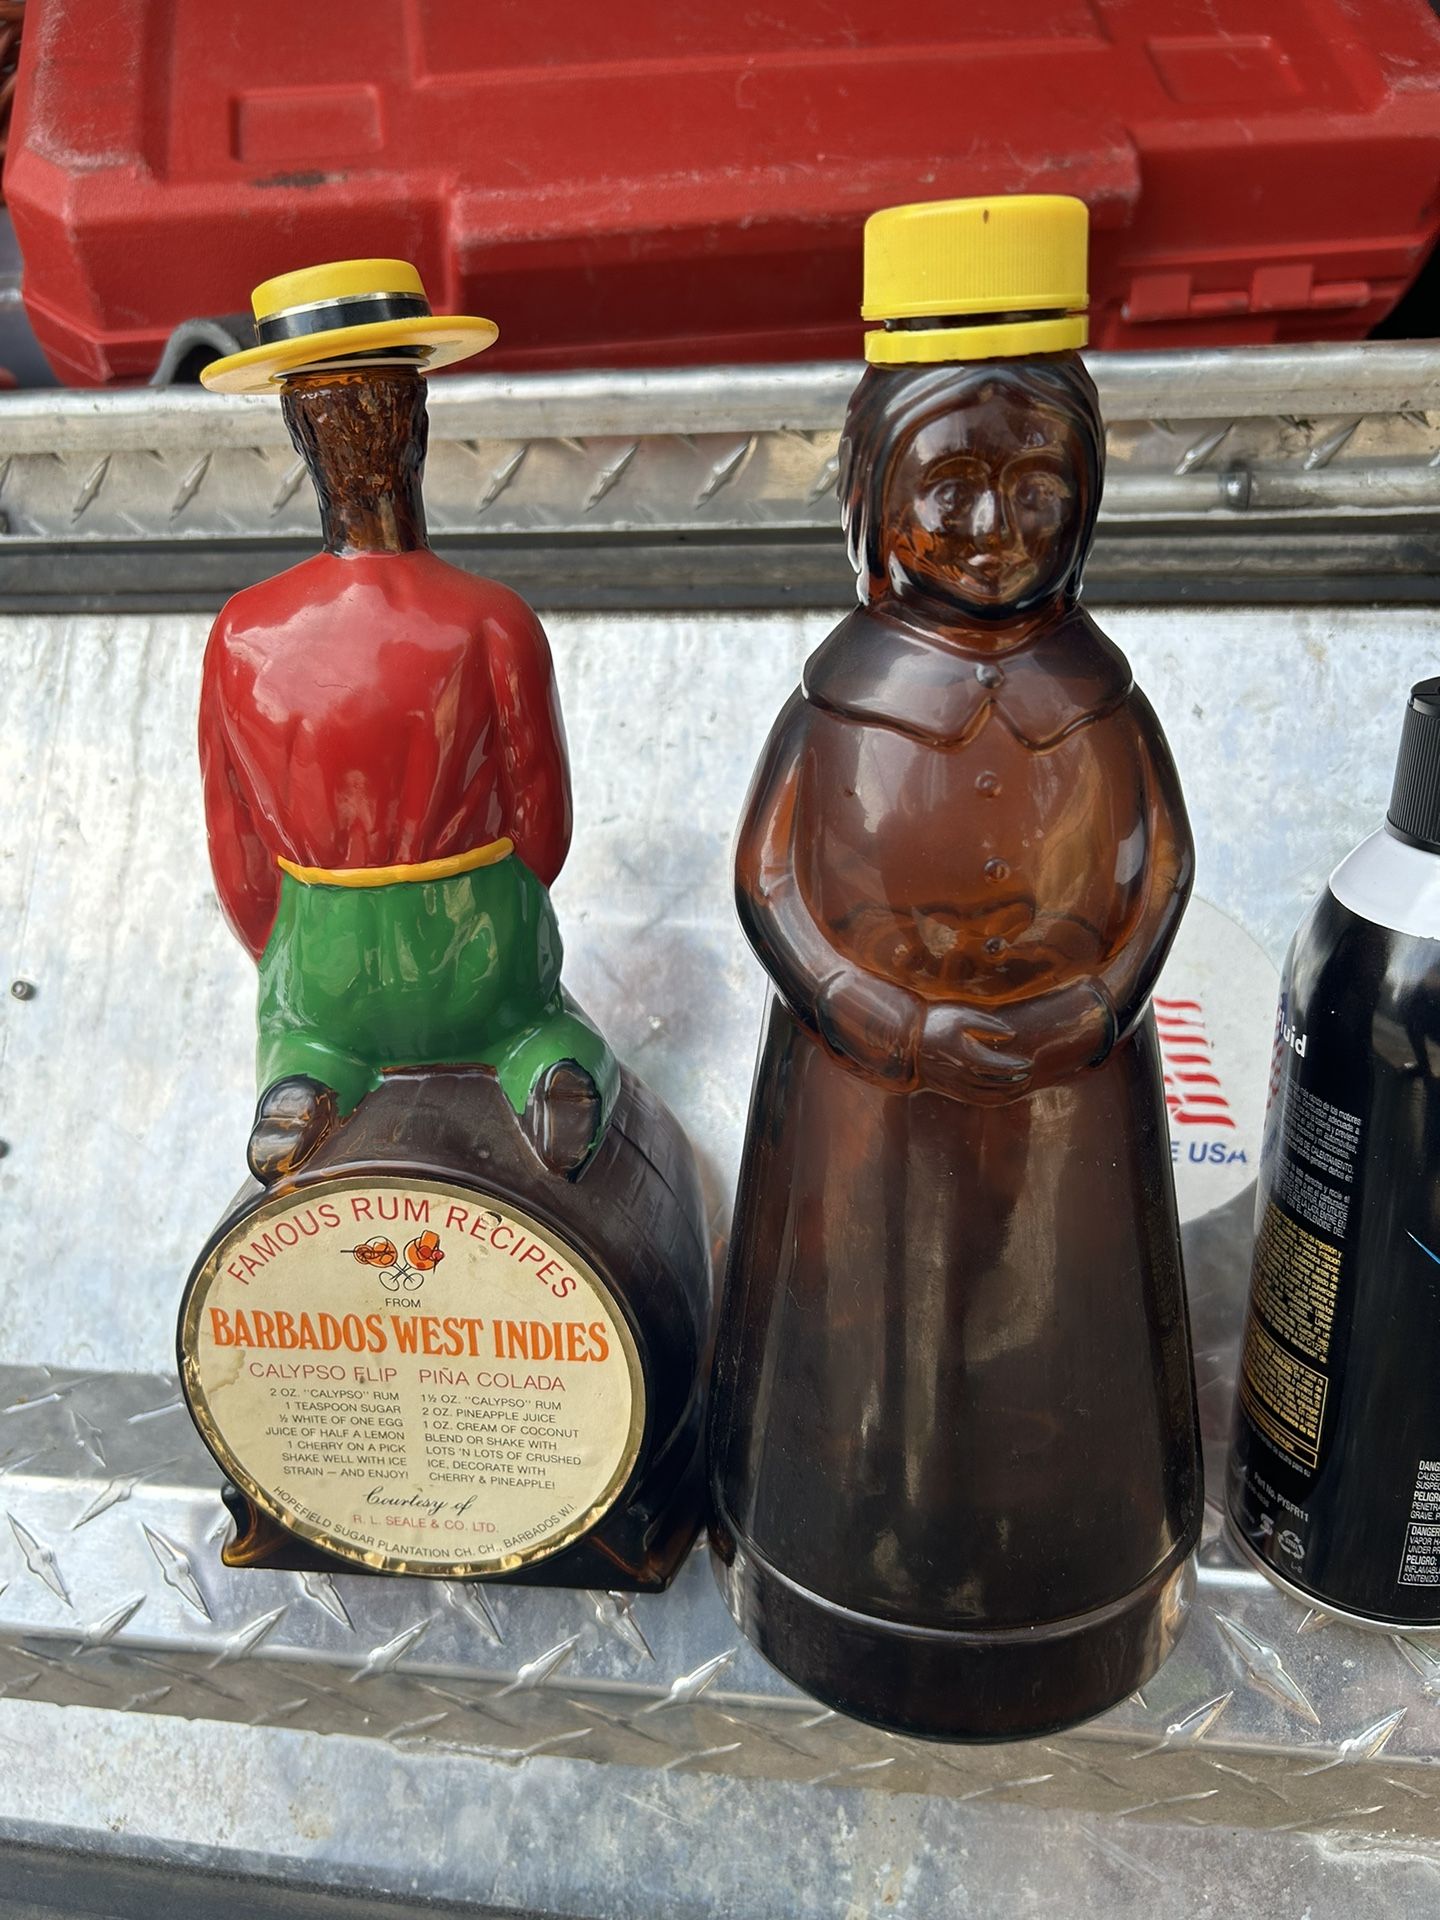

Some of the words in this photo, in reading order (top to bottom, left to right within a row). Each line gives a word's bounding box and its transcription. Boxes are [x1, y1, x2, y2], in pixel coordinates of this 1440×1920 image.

[1330, 1105, 1338, 1116] los
[1338, 1110, 1361, 1126] motores
[1328, 1115, 1354, 1133] adecuada
[1355, 1127, 1360, 1135] a
[1331, 1126, 1335, 1136] y
[1335, 1128, 1359, 1144] previene
[1188, 1142, 1248, 1163] USA
[1345, 1174, 1353, 1183] en
[1324, 1185, 1329, 1194] y
[1344, 1195, 1351, 1204] el
[1318, 1200, 1327, 1211] NO
[1327, 1204, 1348, 1221] UTILICE
[1302, 1209, 1333, 1232] SOLENOIDE
[1332, 1226, 1345, 1239] DEL
[1320, 1209, 1338, 1226] ENTRE
[1338, 1219, 1347, 1230] EN
[227, 1204, 341, 1285] FAMOUS
[351, 1196, 429, 1223] RUM
[445, 1205, 577, 1299] RECIPES
[1337, 1251, 1342, 1259] y
[1329, 1282, 1338, 1291] de
[1331, 1274, 1338, 1283] de
[385, 1297, 421, 1309] FROM
[209, 1307, 388, 1354] BARBADOS
[390, 1315, 484, 1357] WEST
[492, 1319, 610, 1362] INDIES
[249, 1362, 346, 1381] CALYPSO
[354, 1366, 398, 1383] FLIP
[419, 1367, 470, 1386] PIÑA
[477, 1371, 566, 1392] COLADA
[270, 1388, 277, 1397] 2
[280, 1388, 300, 1398] OZ.
[373, 1391, 399, 1401] RUM
[1314, 1384, 1323, 1393] de
[286, 1401, 290, 1410] 1
[295, 1401, 357, 1413] TEASPOON
[360, 1404, 401, 1414] SUGAR
[441, 1395, 461, 1405] OZ.
[535, 1400, 562, 1410] RUM
[292, 1415, 327, 1424] WHITE
[331, 1416, 346, 1425] OF
[350, 1416, 375, 1426] ONE
[378, 1418, 404, 1427] EGG
[422, 1407, 429, 1416] 2
[432, 1407, 453, 1417] OZ.
[456, 1409, 519, 1421] PINEAPPLE
[523, 1413, 556, 1423] JUICE
[265, 1427, 297, 1437] JUICE
[301, 1428, 317, 1437] OF
[320, 1429, 349, 1438] HALF
[353, 1430, 361, 1439] A
[364, 1431, 405, 1440] LEMON
[423, 1421, 428, 1429] 1
[432, 1421, 453, 1430] OZ.
[456, 1422, 497, 1433] CREAM
[500, 1425, 517, 1434] OF
[520, 1426, 579, 1438] COCONUT
[288, 1441, 293, 1449] 1
[297, 1441, 344, 1451] CHERRY
[347, 1442, 365, 1451] ON
[368, 1443, 376, 1452] A
[379, 1444, 407, 1453] PICK
[425, 1434, 463, 1444] BLEND
[466, 1436, 484, 1445] OR
[487, 1437, 525, 1448] SHAKE
[528, 1441, 557, 1450] WITH
[281, 1453, 320, 1463] SHAKE
[322, 1454, 354, 1464] WELL
[356, 1456, 385, 1465] WITH
[388, 1457, 407, 1466] ICE
[426, 1446, 455, 1456] LOTS
[474, 1449, 504, 1459] LOTS
[507, 1451, 523, 1460] OF
[526, 1453, 582, 1466] CRUSHED
[283, 1466, 324, 1476] STRAIN
[340, 1468, 365, 1478] AND
[368, 1469, 409, 1479] ENJOY!
[453, 1460, 514, 1474] DECORATE
[517, 1466, 546, 1476] WITH
[429, 1472, 475, 1483] CHERRY
[479, 1475, 487, 1484] &
[491, 1477, 555, 1490] PINEAPPLE!
[1266, 1483, 1276, 1499] No.
[363, 1485, 447, 1516] Courtesy
[451, 1494, 478, 1516] of
[273, 1486, 332, 1528] HOPEFIELD
[333, 1524, 375, 1547] SUGAR
[377, 1540, 450, 1558] PLANTATION
[455, 1547, 476, 1558] CH.
[503, 1515, 561, 1549] BARBADOS
[559, 1503, 578, 1517] W.I.
[1410, 1510, 1433, 1520] GRAVE
[353, 1514, 365, 1525] R.
[370, 1516, 381, 1526] L.
[385, 1515, 427, 1529] SEALE
[430, 1519, 440, 1529] &
[444, 1520, 468, 1531] CO.
[473, 1522, 499, 1533] LTD.
[1410, 1536, 1432, 1545] VAPOR
[1408, 1545, 1431, 1554] UNDER
[1406, 1555, 1438, 1565] PELIGRO:
[1402, 1573, 1439, 1583] CONTENIDO
